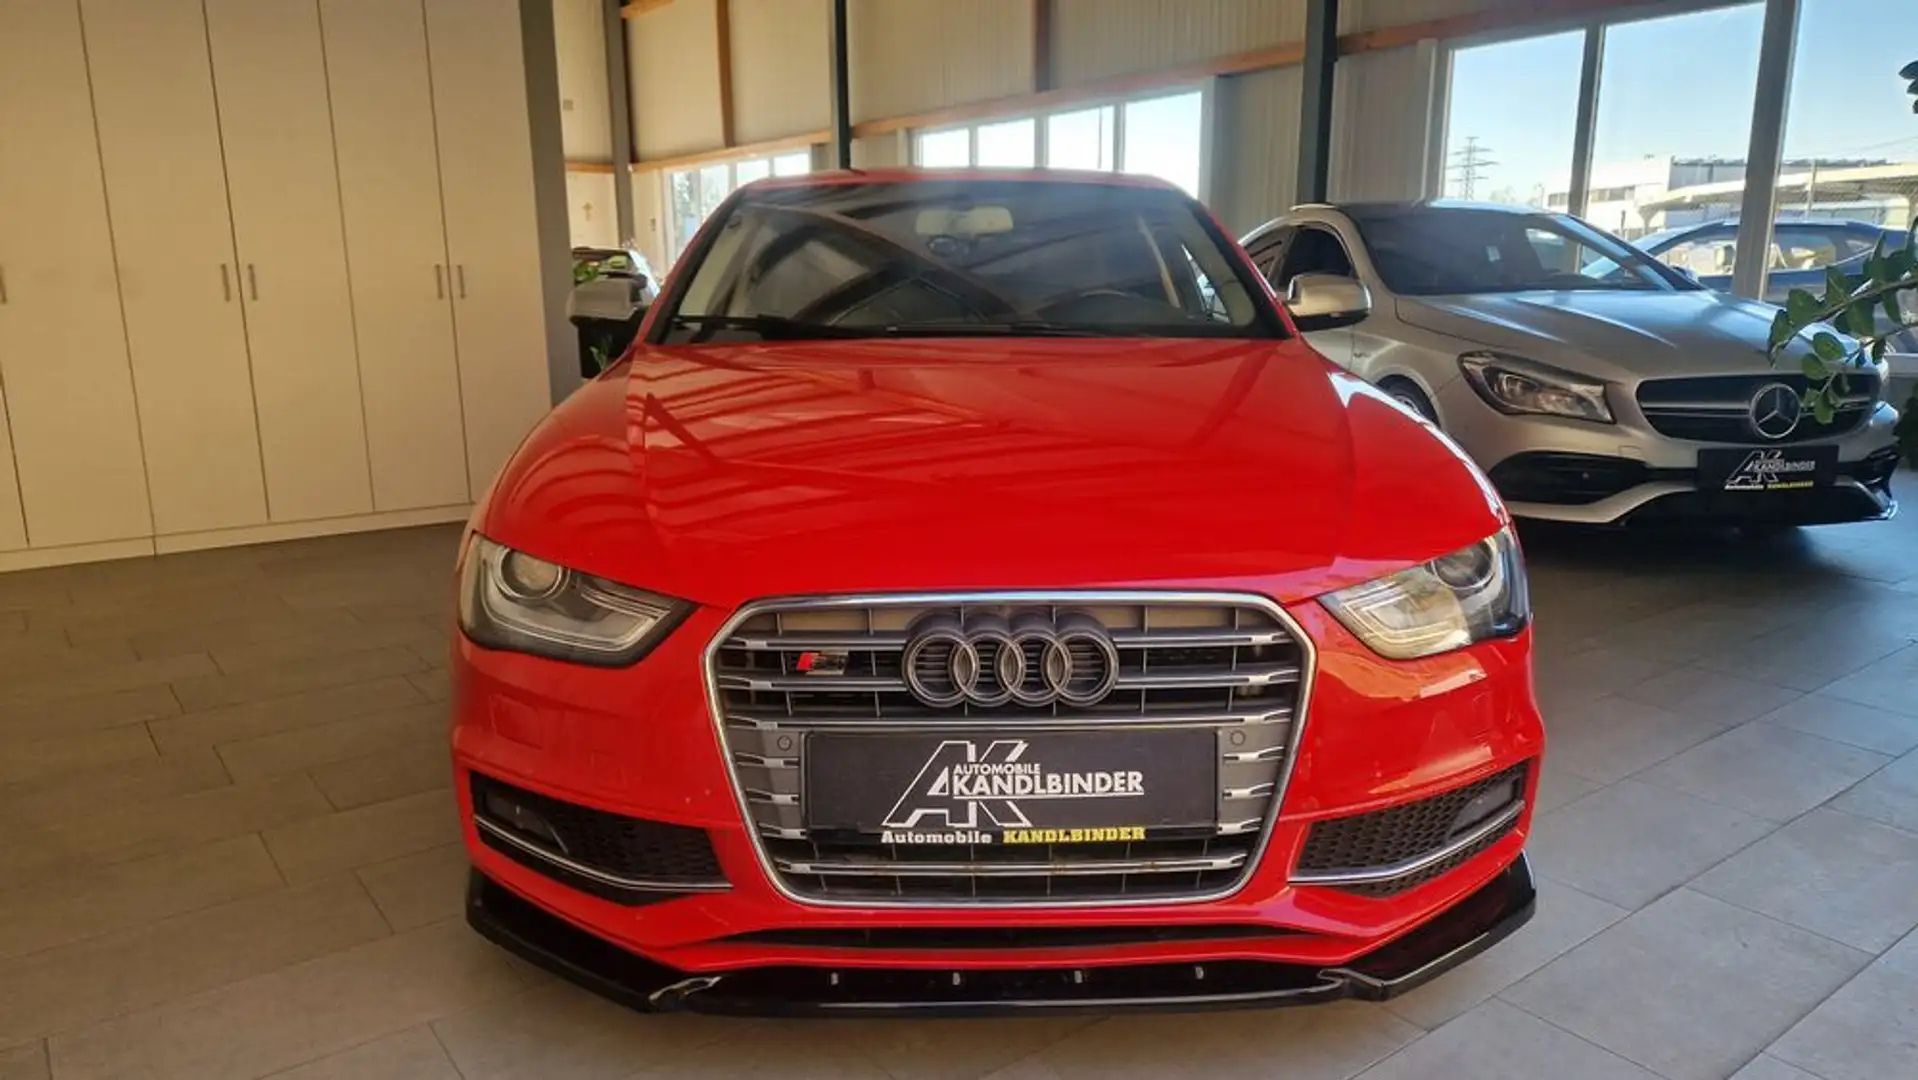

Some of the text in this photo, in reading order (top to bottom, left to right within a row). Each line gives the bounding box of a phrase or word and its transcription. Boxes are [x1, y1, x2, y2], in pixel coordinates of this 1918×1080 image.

[953, 763, 1041, 775] AUTOMOBILE
[881, 740, 1034, 828] AK
[952, 771, 1145, 796] KANDLBINDER
[881, 827, 1147, 844] Automobile KANDLBINDER
